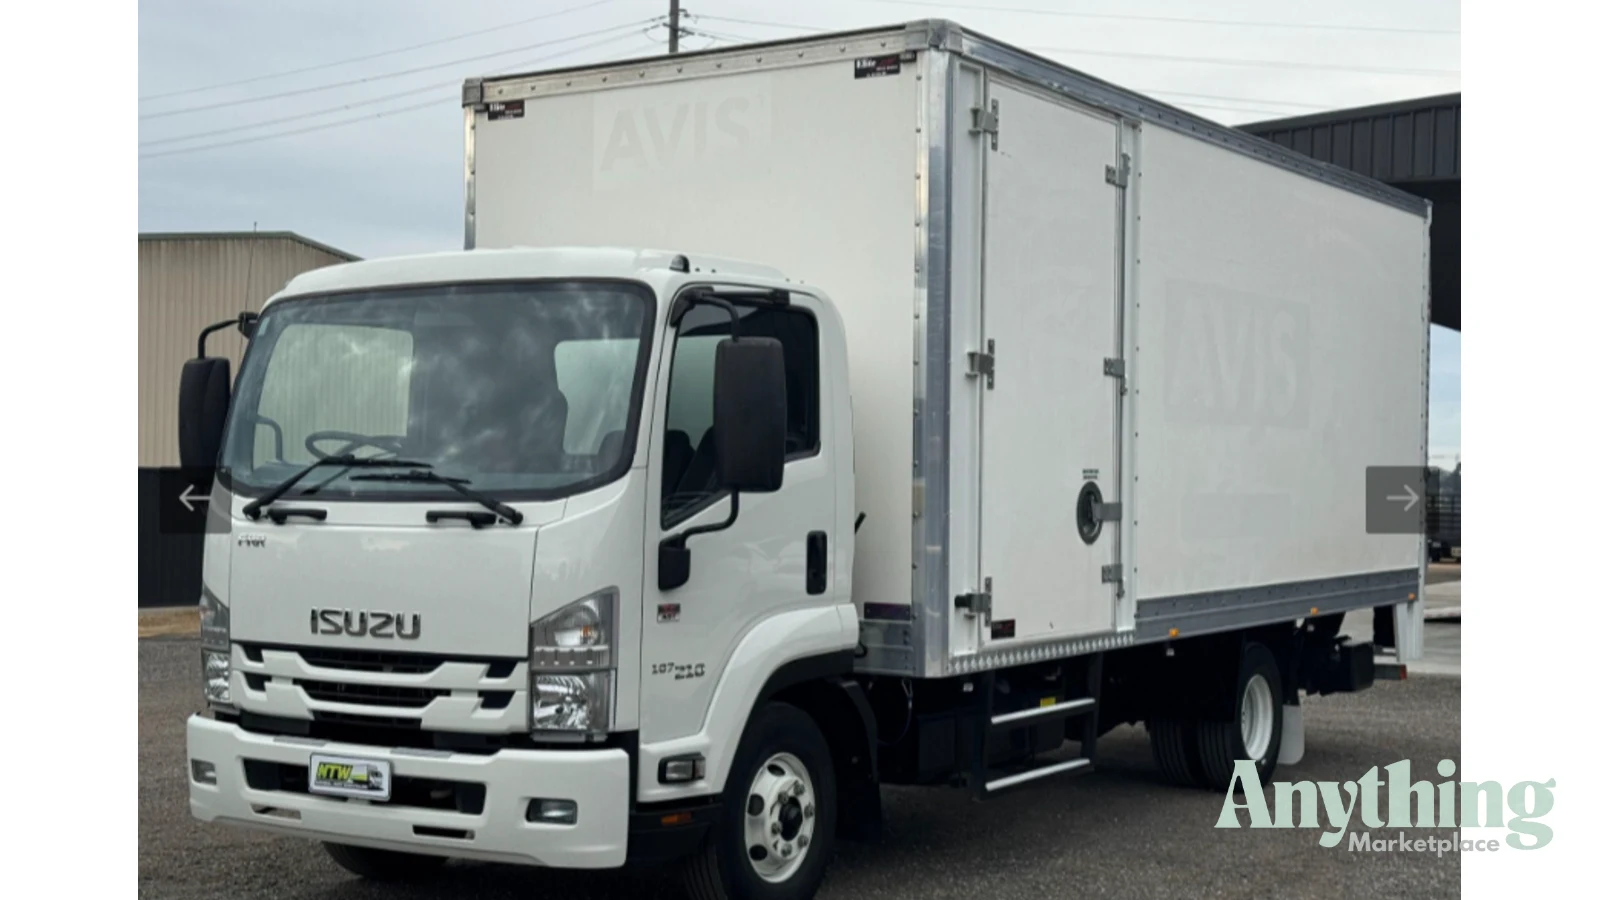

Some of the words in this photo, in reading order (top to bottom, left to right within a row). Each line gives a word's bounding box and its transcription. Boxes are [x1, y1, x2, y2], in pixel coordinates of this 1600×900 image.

[600, 96, 751, 171] AVIS
[1168, 293, 1298, 419] AVIS
[310, 608, 421, 640] ISUZU
[651, 662, 675, 675] 107
[317, 762, 353, 781] NTW
